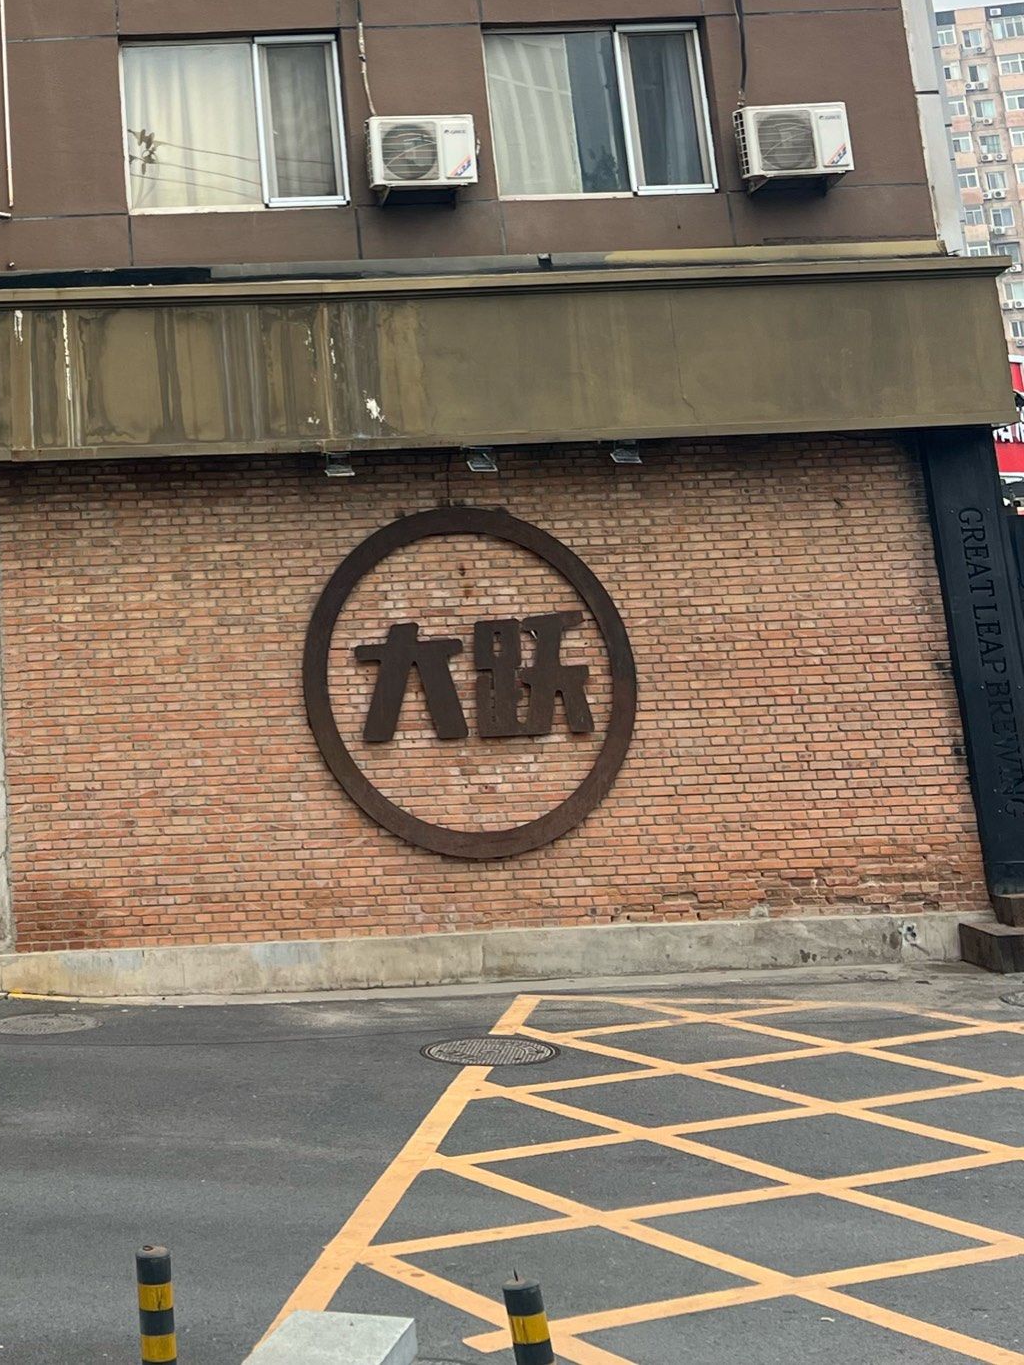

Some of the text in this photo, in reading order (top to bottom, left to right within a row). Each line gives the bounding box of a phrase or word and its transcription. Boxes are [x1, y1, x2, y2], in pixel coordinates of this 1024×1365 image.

[354, 610, 596, 742] 大跃
[958, 507, 1024, 818] GREAT LEAP BREWING
